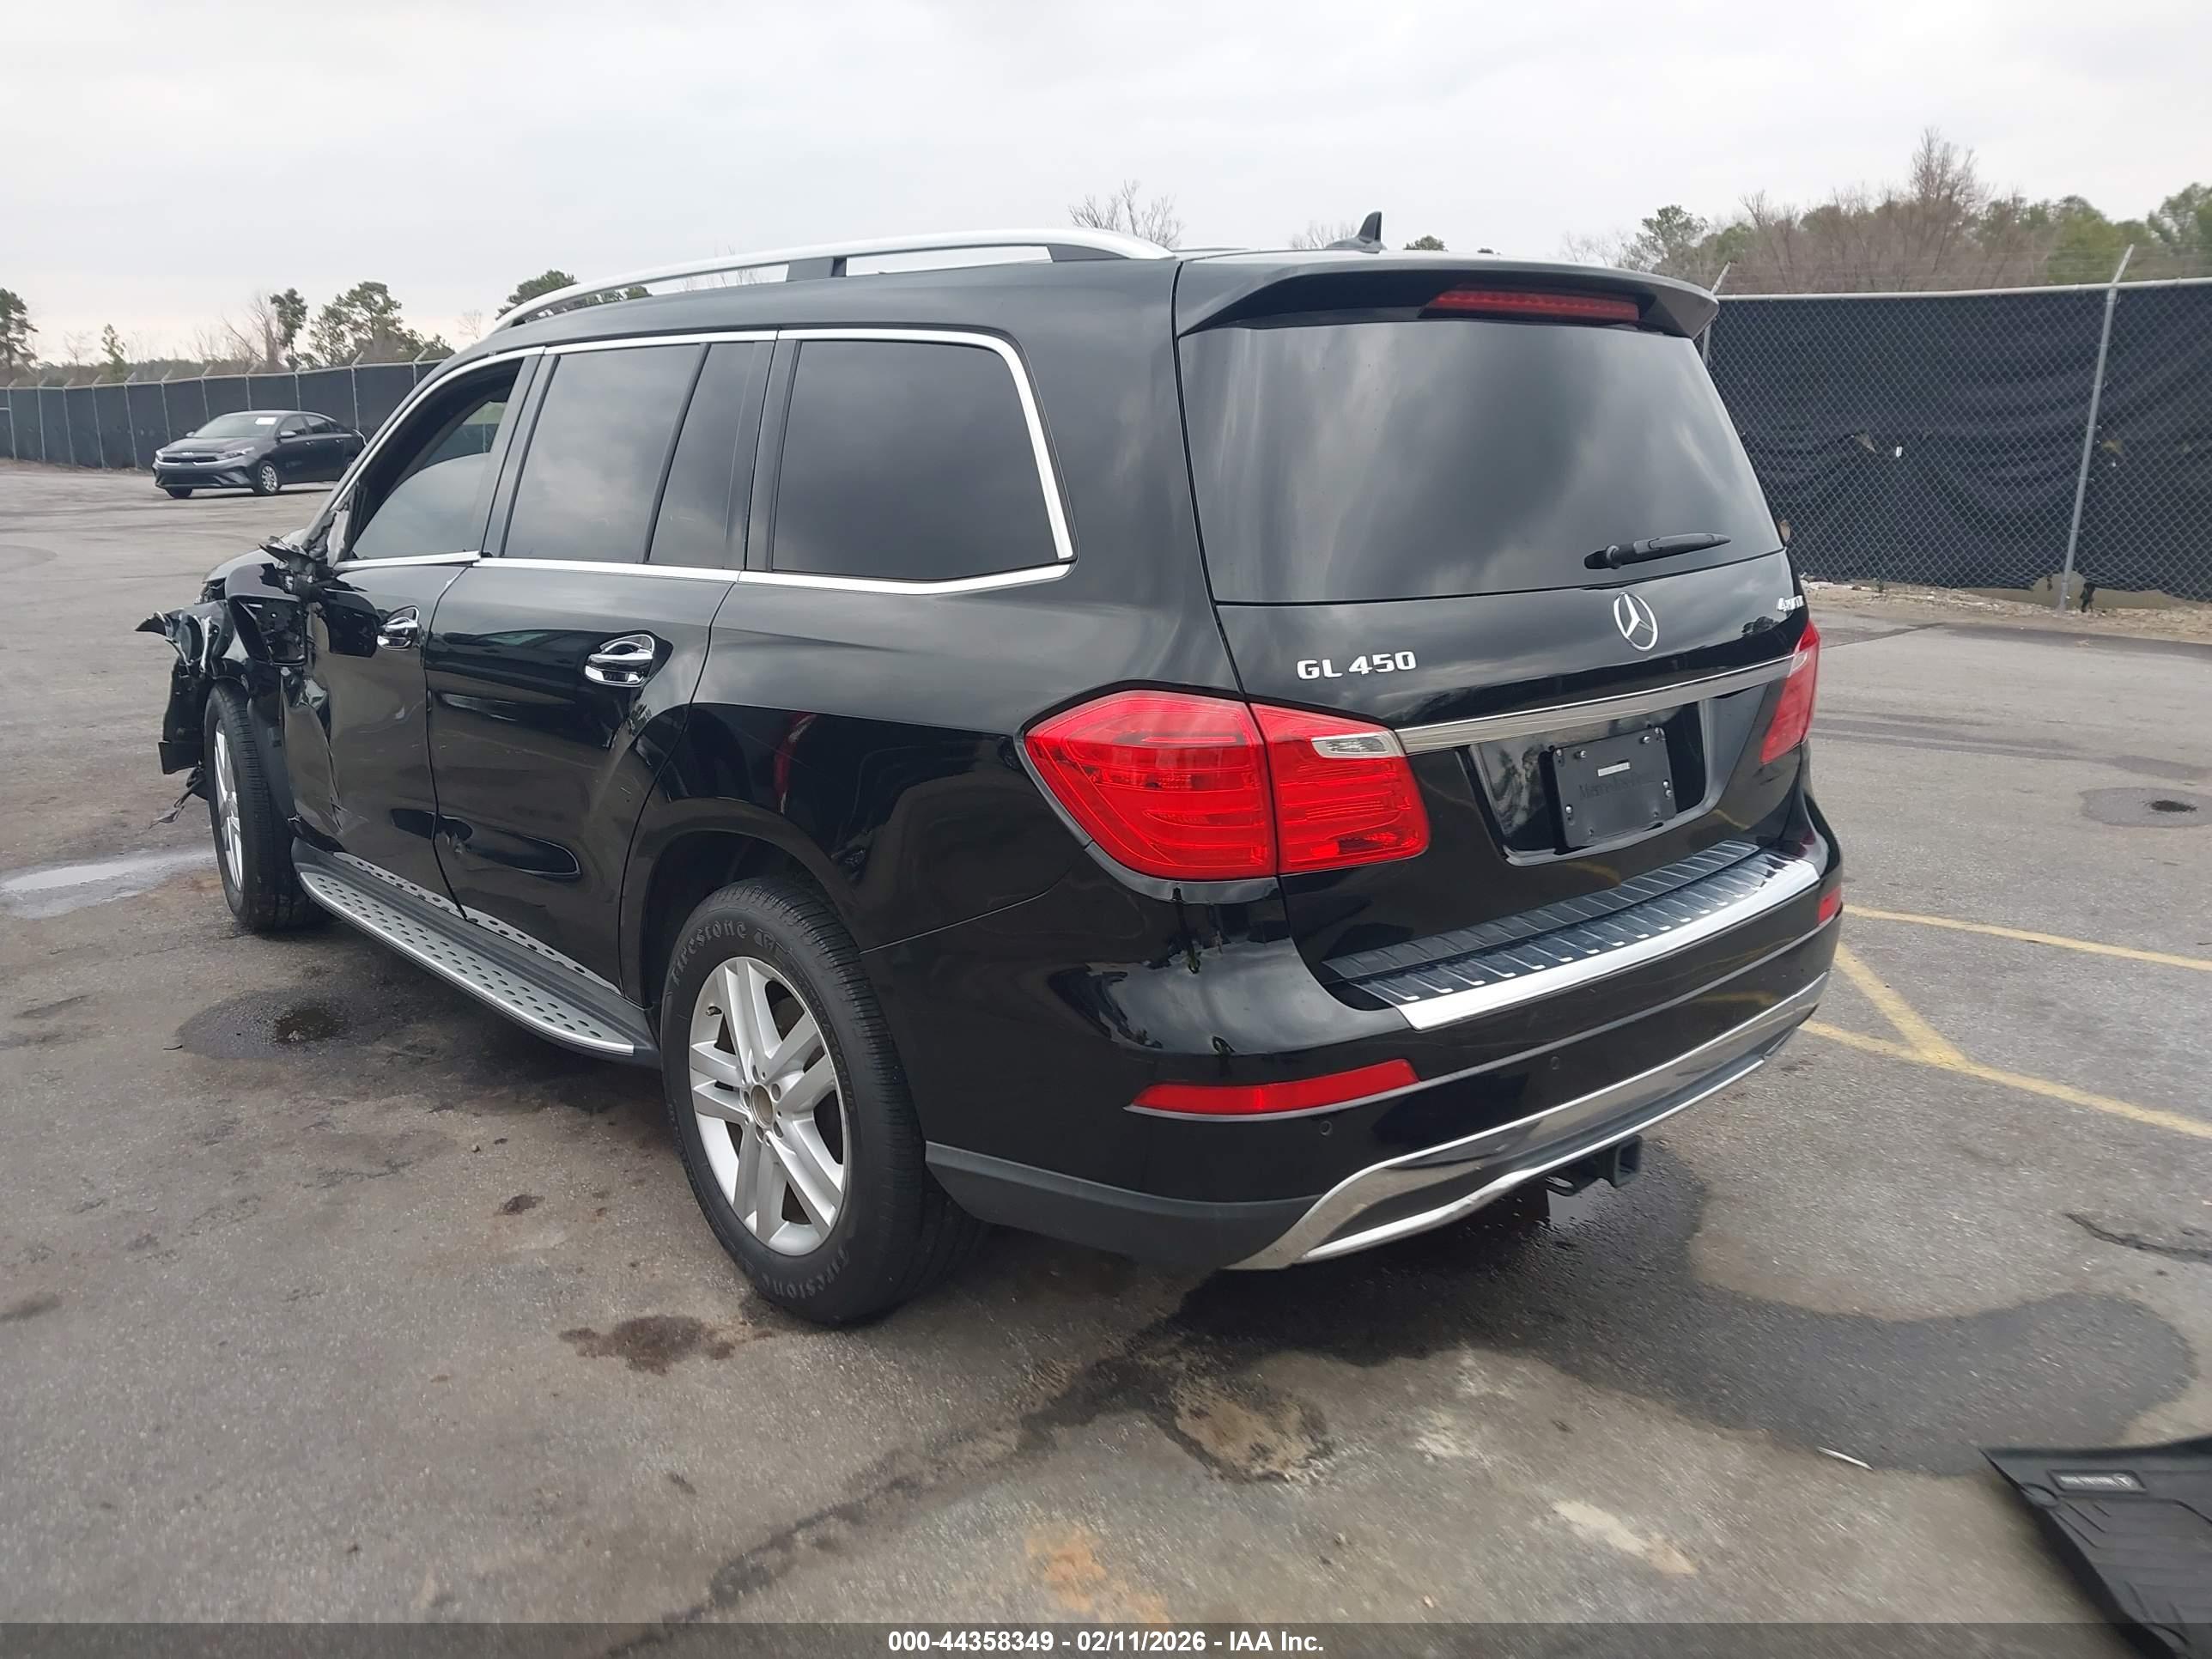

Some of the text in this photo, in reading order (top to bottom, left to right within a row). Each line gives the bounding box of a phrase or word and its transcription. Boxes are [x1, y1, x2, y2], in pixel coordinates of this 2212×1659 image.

[1297, 650, 1417, 680] GL 450
[672, 921, 747, 988] Firestone
